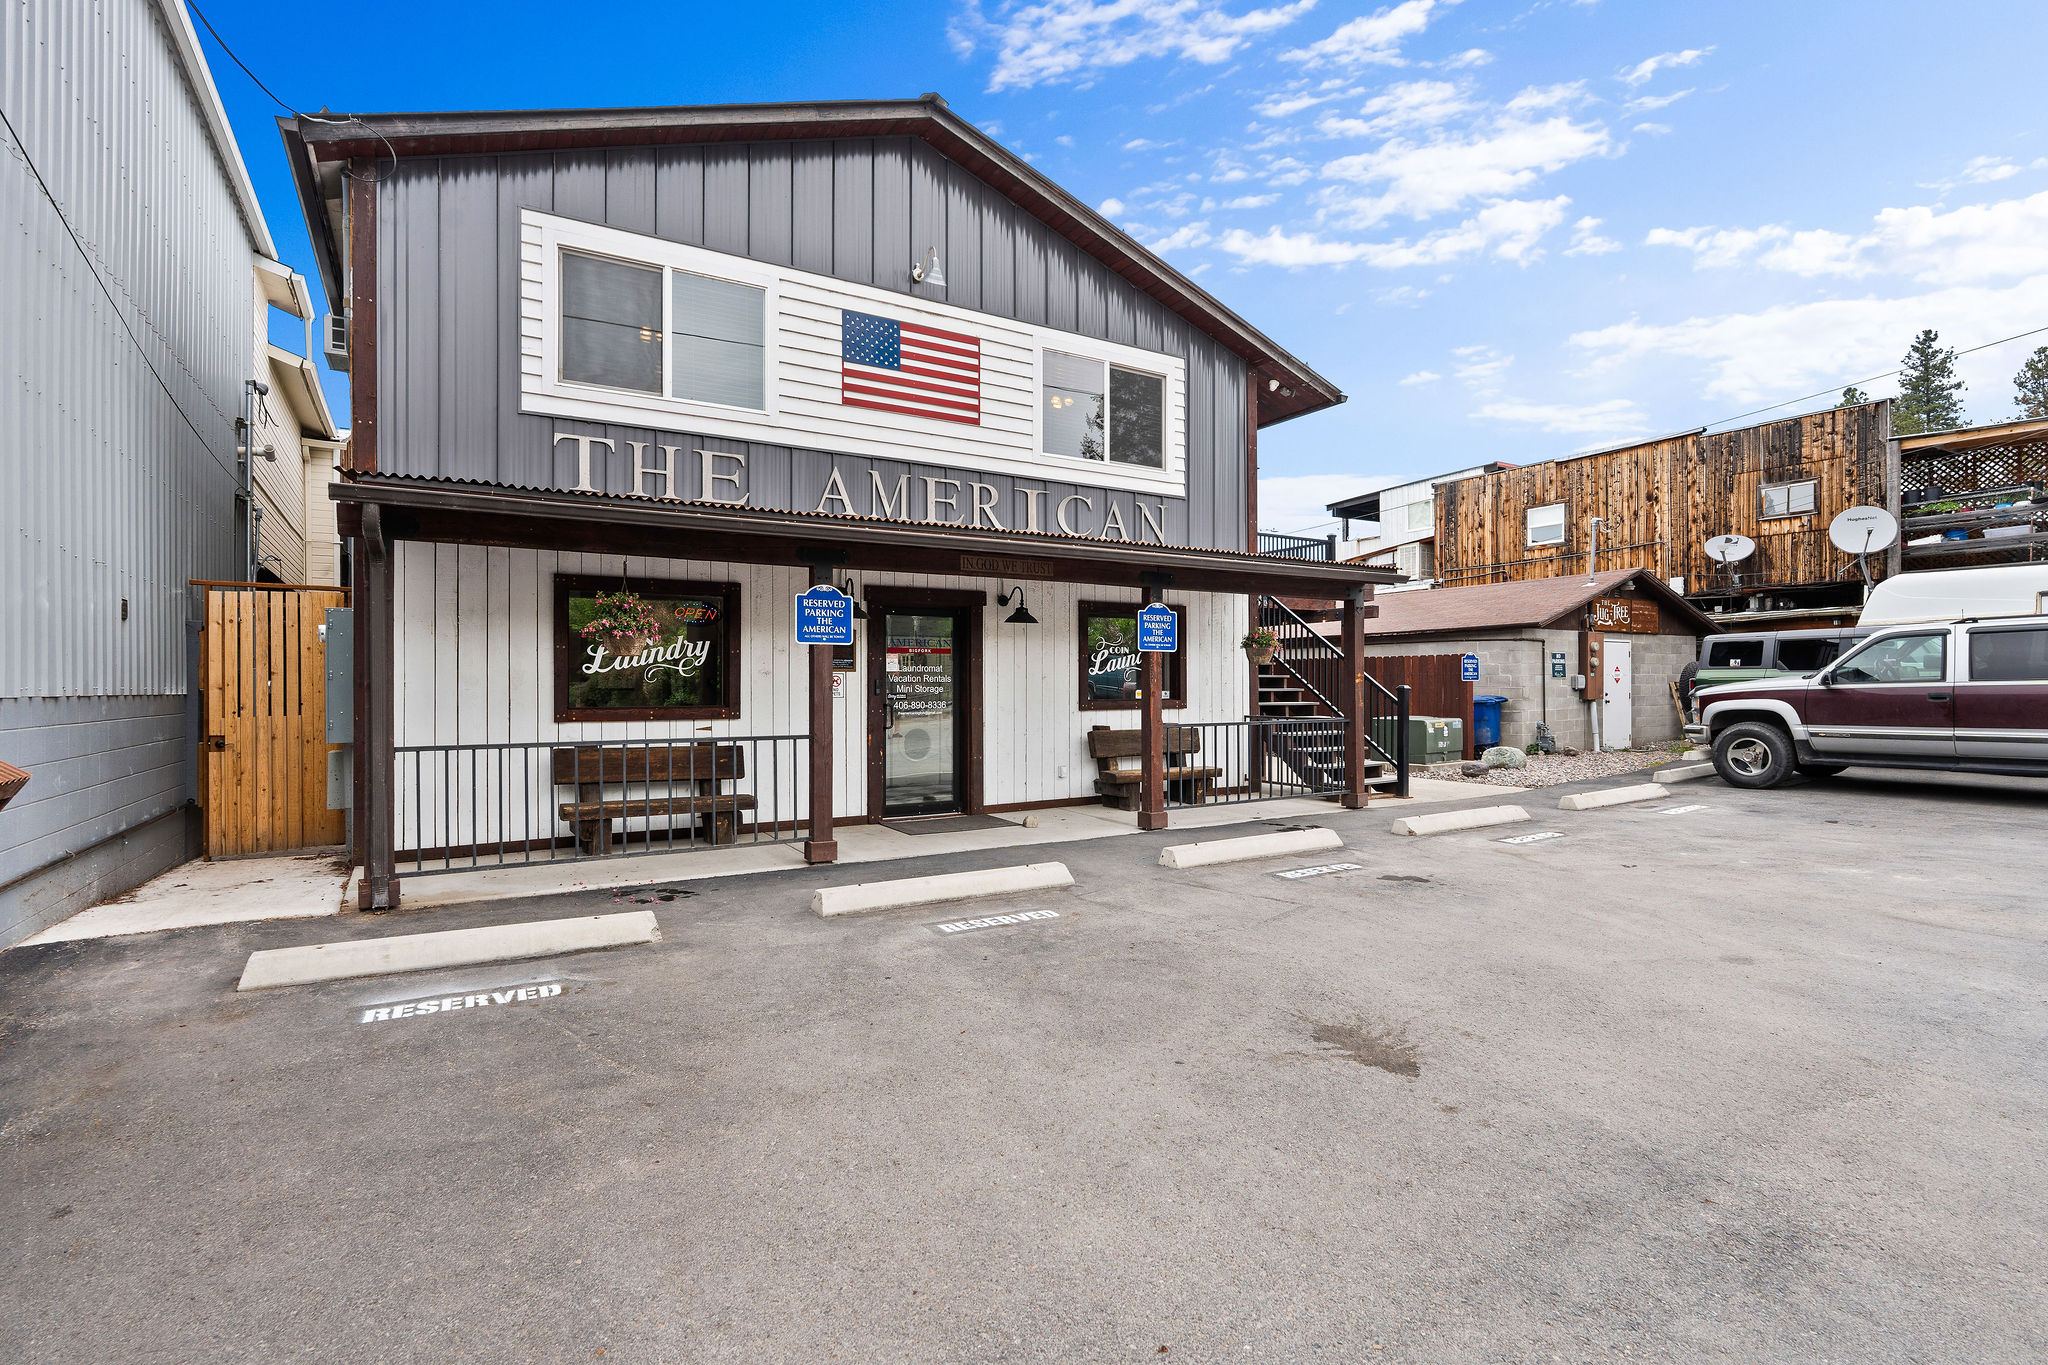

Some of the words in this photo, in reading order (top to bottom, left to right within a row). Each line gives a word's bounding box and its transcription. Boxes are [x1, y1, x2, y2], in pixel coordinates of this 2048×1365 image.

[554, 432, 750, 505] THE
[813, 466, 1169, 544] AMERICAN
[962, 556, 974, 569] IN
[976, 557, 1000, 570] GOD
[1001, 560, 1018, 572] WE
[1022, 561, 1052, 574] TRUST
[803, 599, 846, 608] RESERVED
[674, 607, 717, 620] OPEN
[805, 608, 844, 617] PARKING
[817, 617, 832, 625] THE
[1143, 614, 1172, 622] RESERVED
[802, 625, 846, 633] AMERICAN
[889, 638, 952, 648] AMERICAN
[1109, 646, 1129, 654] COIN
[888, 674, 921, 683] Vacation
[923, 674, 951, 683] Rentals
[914, 685, 944, 695] Storage
[893, 701, 947, 709] 406-890-8336
[937, 909, 1060, 933] RESERVED
[361, 984, 562, 1024] RESERVED
